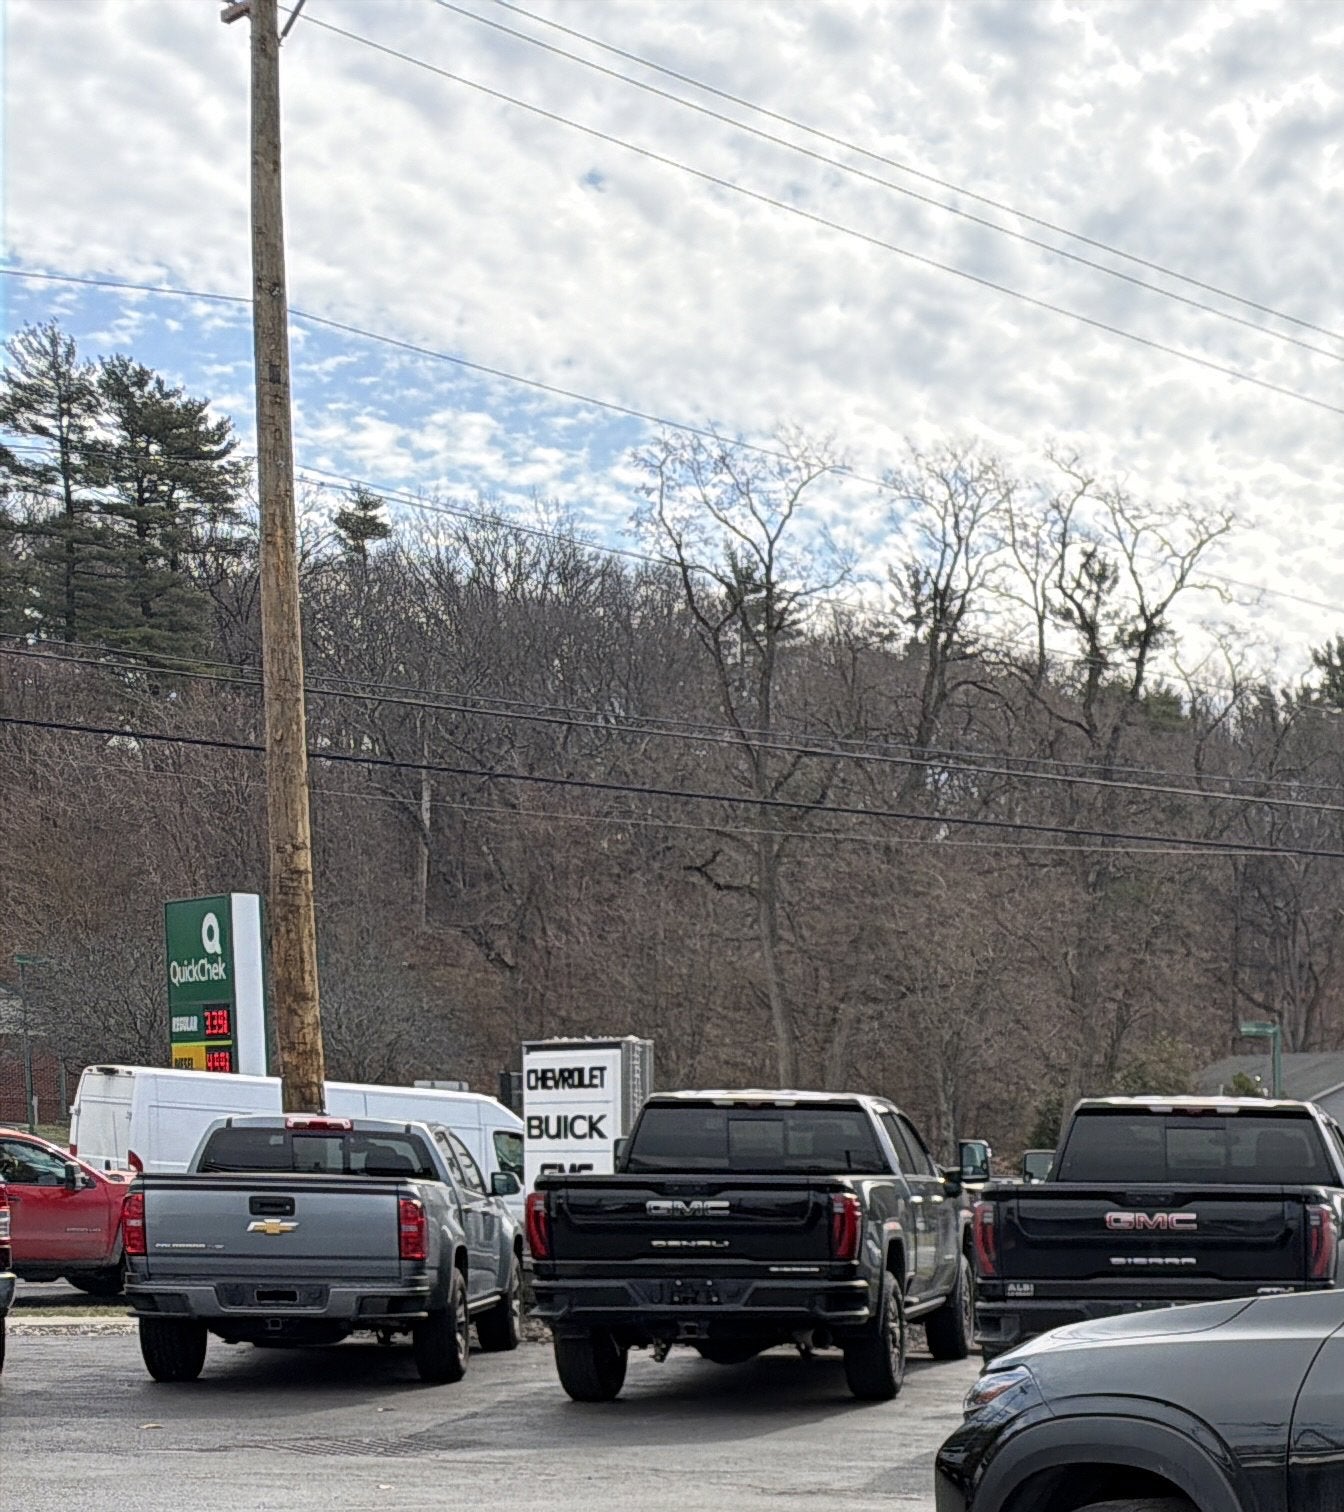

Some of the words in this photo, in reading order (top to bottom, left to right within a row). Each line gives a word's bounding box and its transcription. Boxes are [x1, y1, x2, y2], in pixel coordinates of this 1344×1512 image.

[170, 957, 227, 987] QuickChek
[526, 1066, 607, 1090] CHEVROLET
[527, 1114, 608, 1140] BUICK
[646, 1200, 730, 1216] GMC
[1104, 1212, 1198, 1231] GMC
